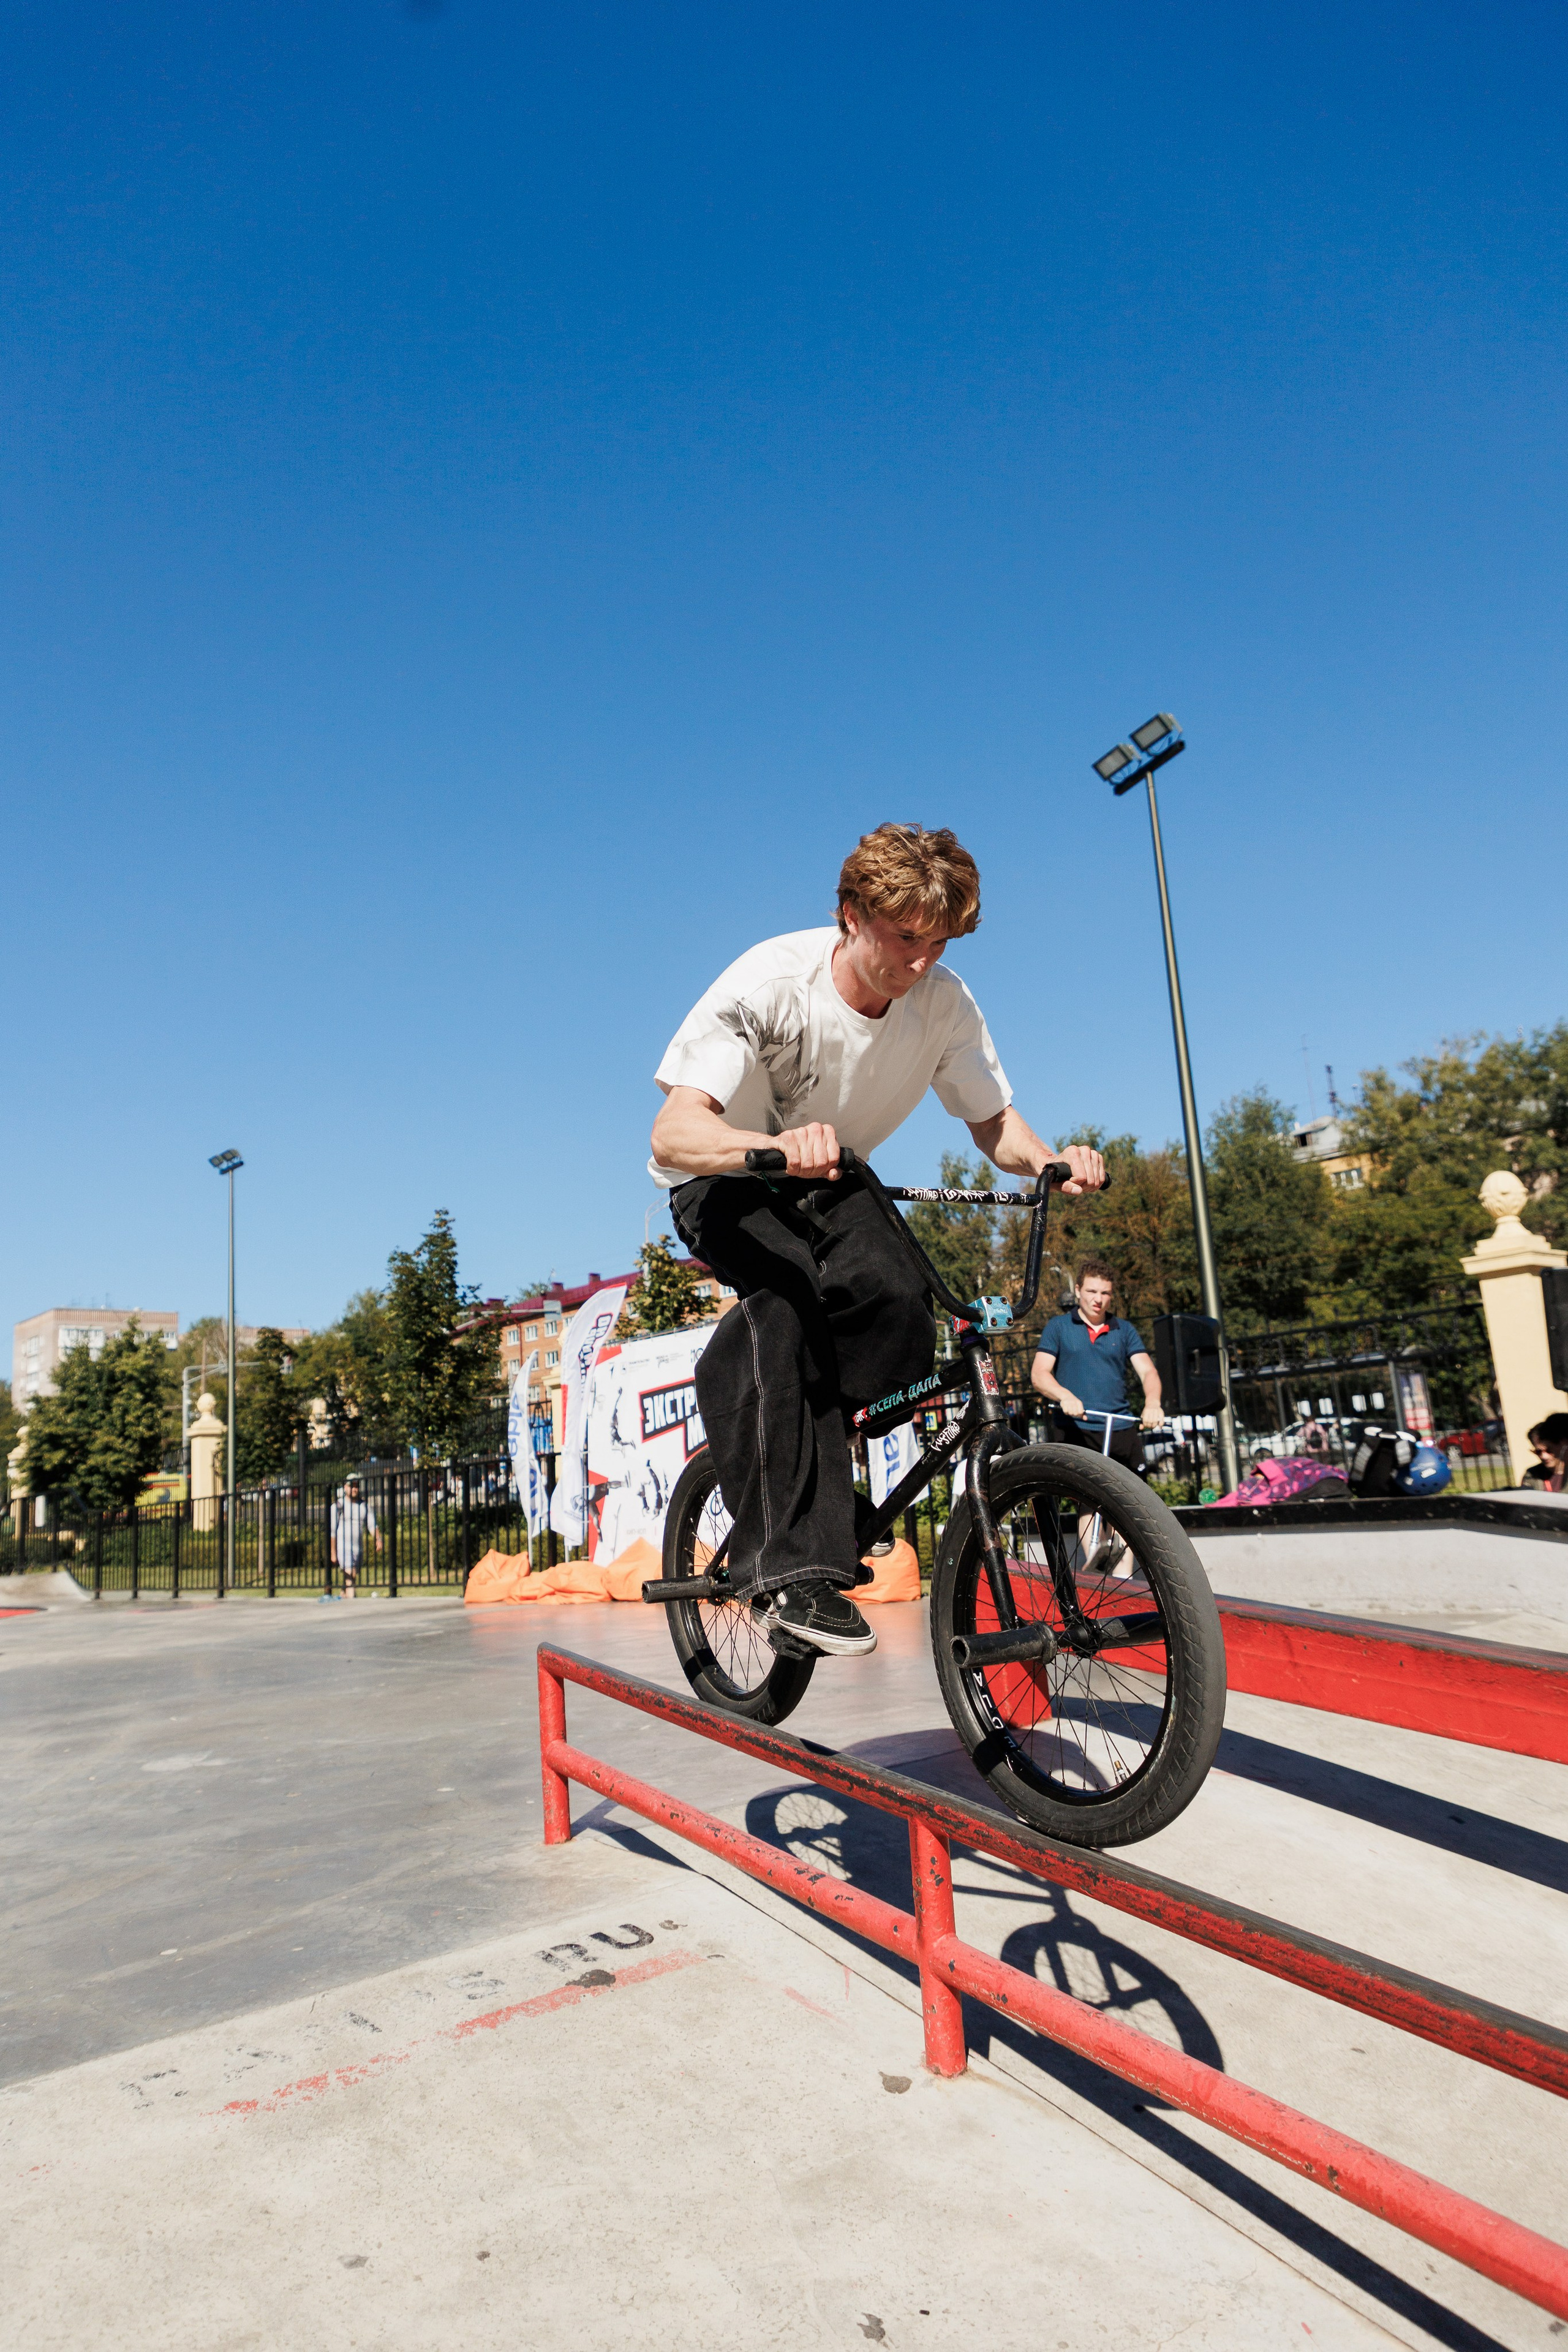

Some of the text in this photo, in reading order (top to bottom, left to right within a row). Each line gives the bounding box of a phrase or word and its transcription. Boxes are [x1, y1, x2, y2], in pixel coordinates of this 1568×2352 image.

[643, 1385, 699, 1434] ЭКСТР
[687, 1412, 707, 1451] М
[973, 1672, 1017, 1748] ECLA
